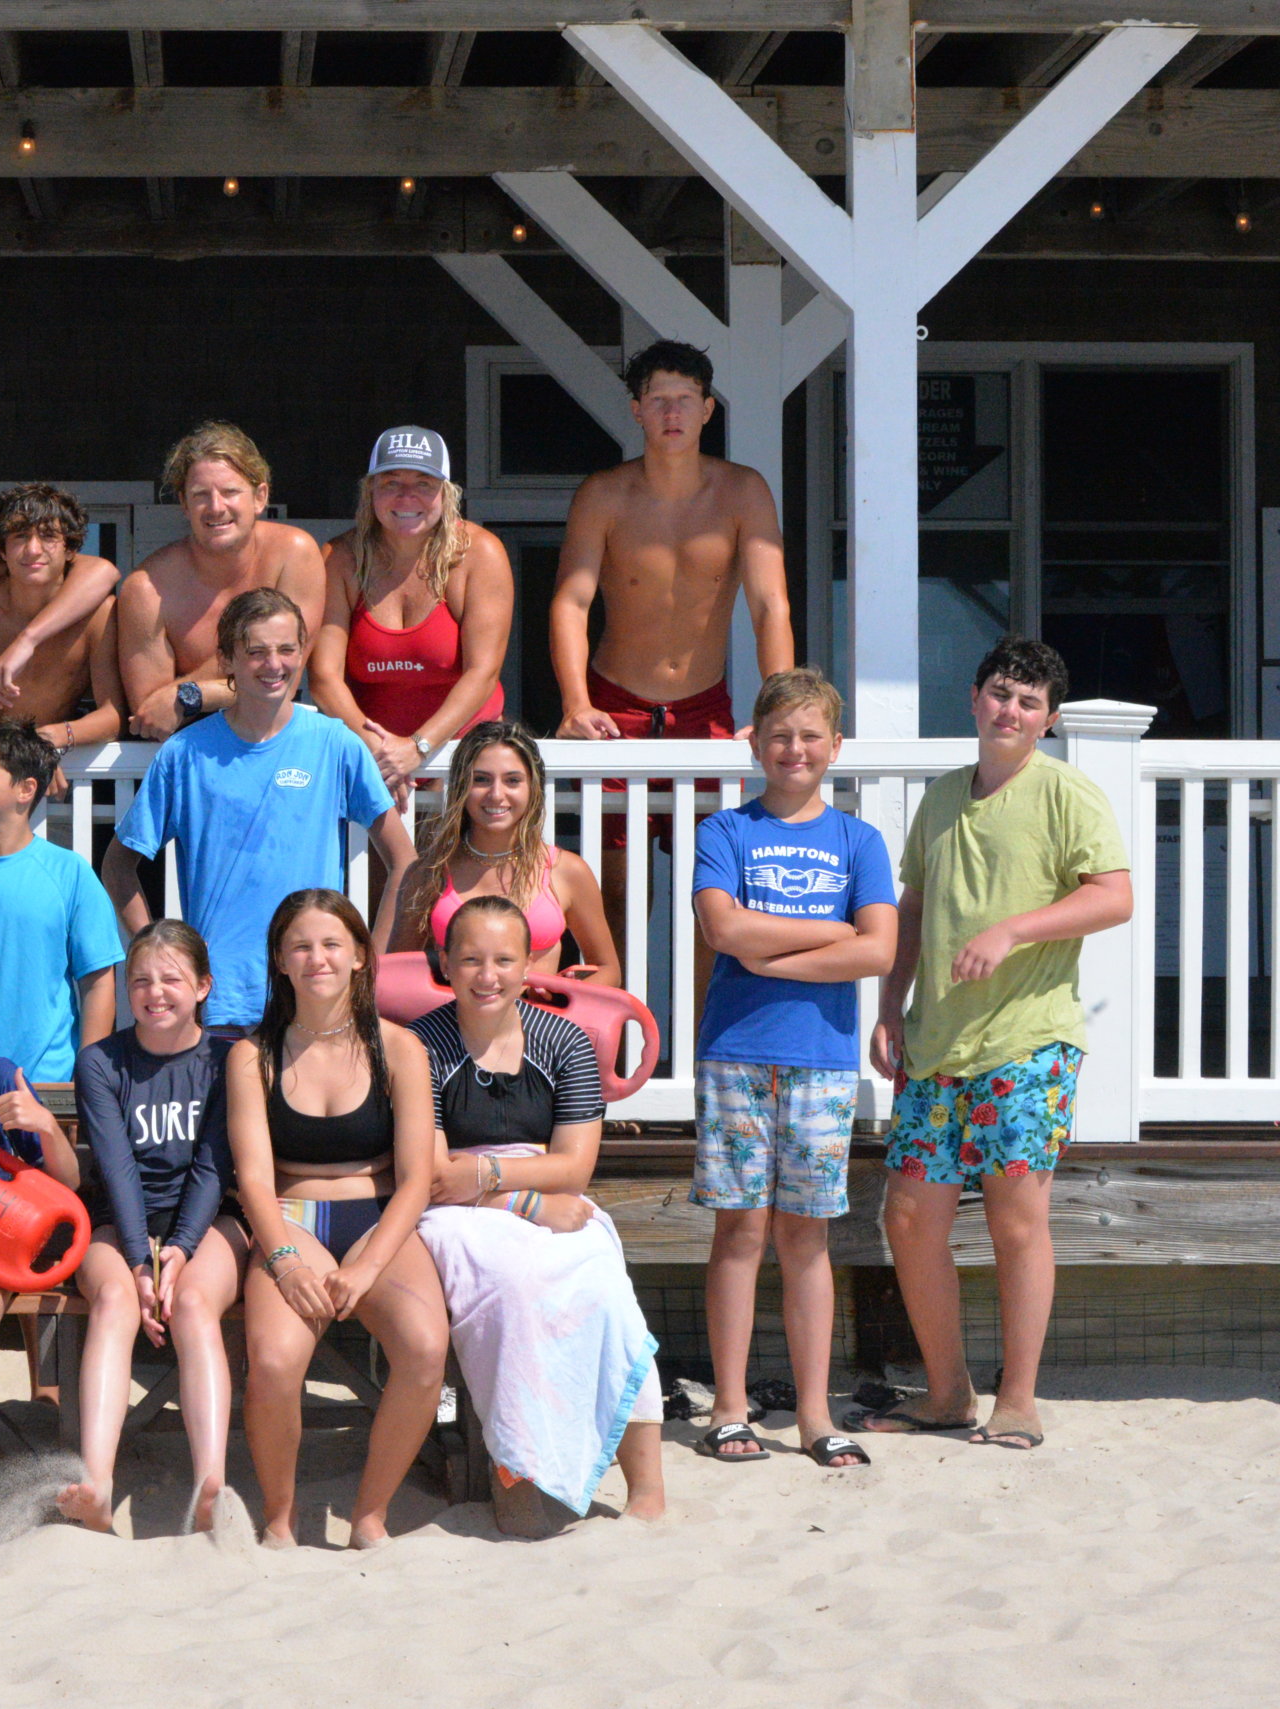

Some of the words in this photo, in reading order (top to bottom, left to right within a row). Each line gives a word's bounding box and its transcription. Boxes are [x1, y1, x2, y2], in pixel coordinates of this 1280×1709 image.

[919, 380, 952, 400] DER
[919, 408, 964, 418] RAGES
[918, 423, 961, 432] REAM
[387, 433, 432, 452] HLA
[919, 437, 959, 447] TZELS
[918, 452, 957, 461] CORN
[751, 845, 840, 867] HAMPTONS
[747, 899, 806, 914] BASEBALL
[135, 1100, 201, 1144] SURF
[721, 1423, 744, 1433] NIKE
